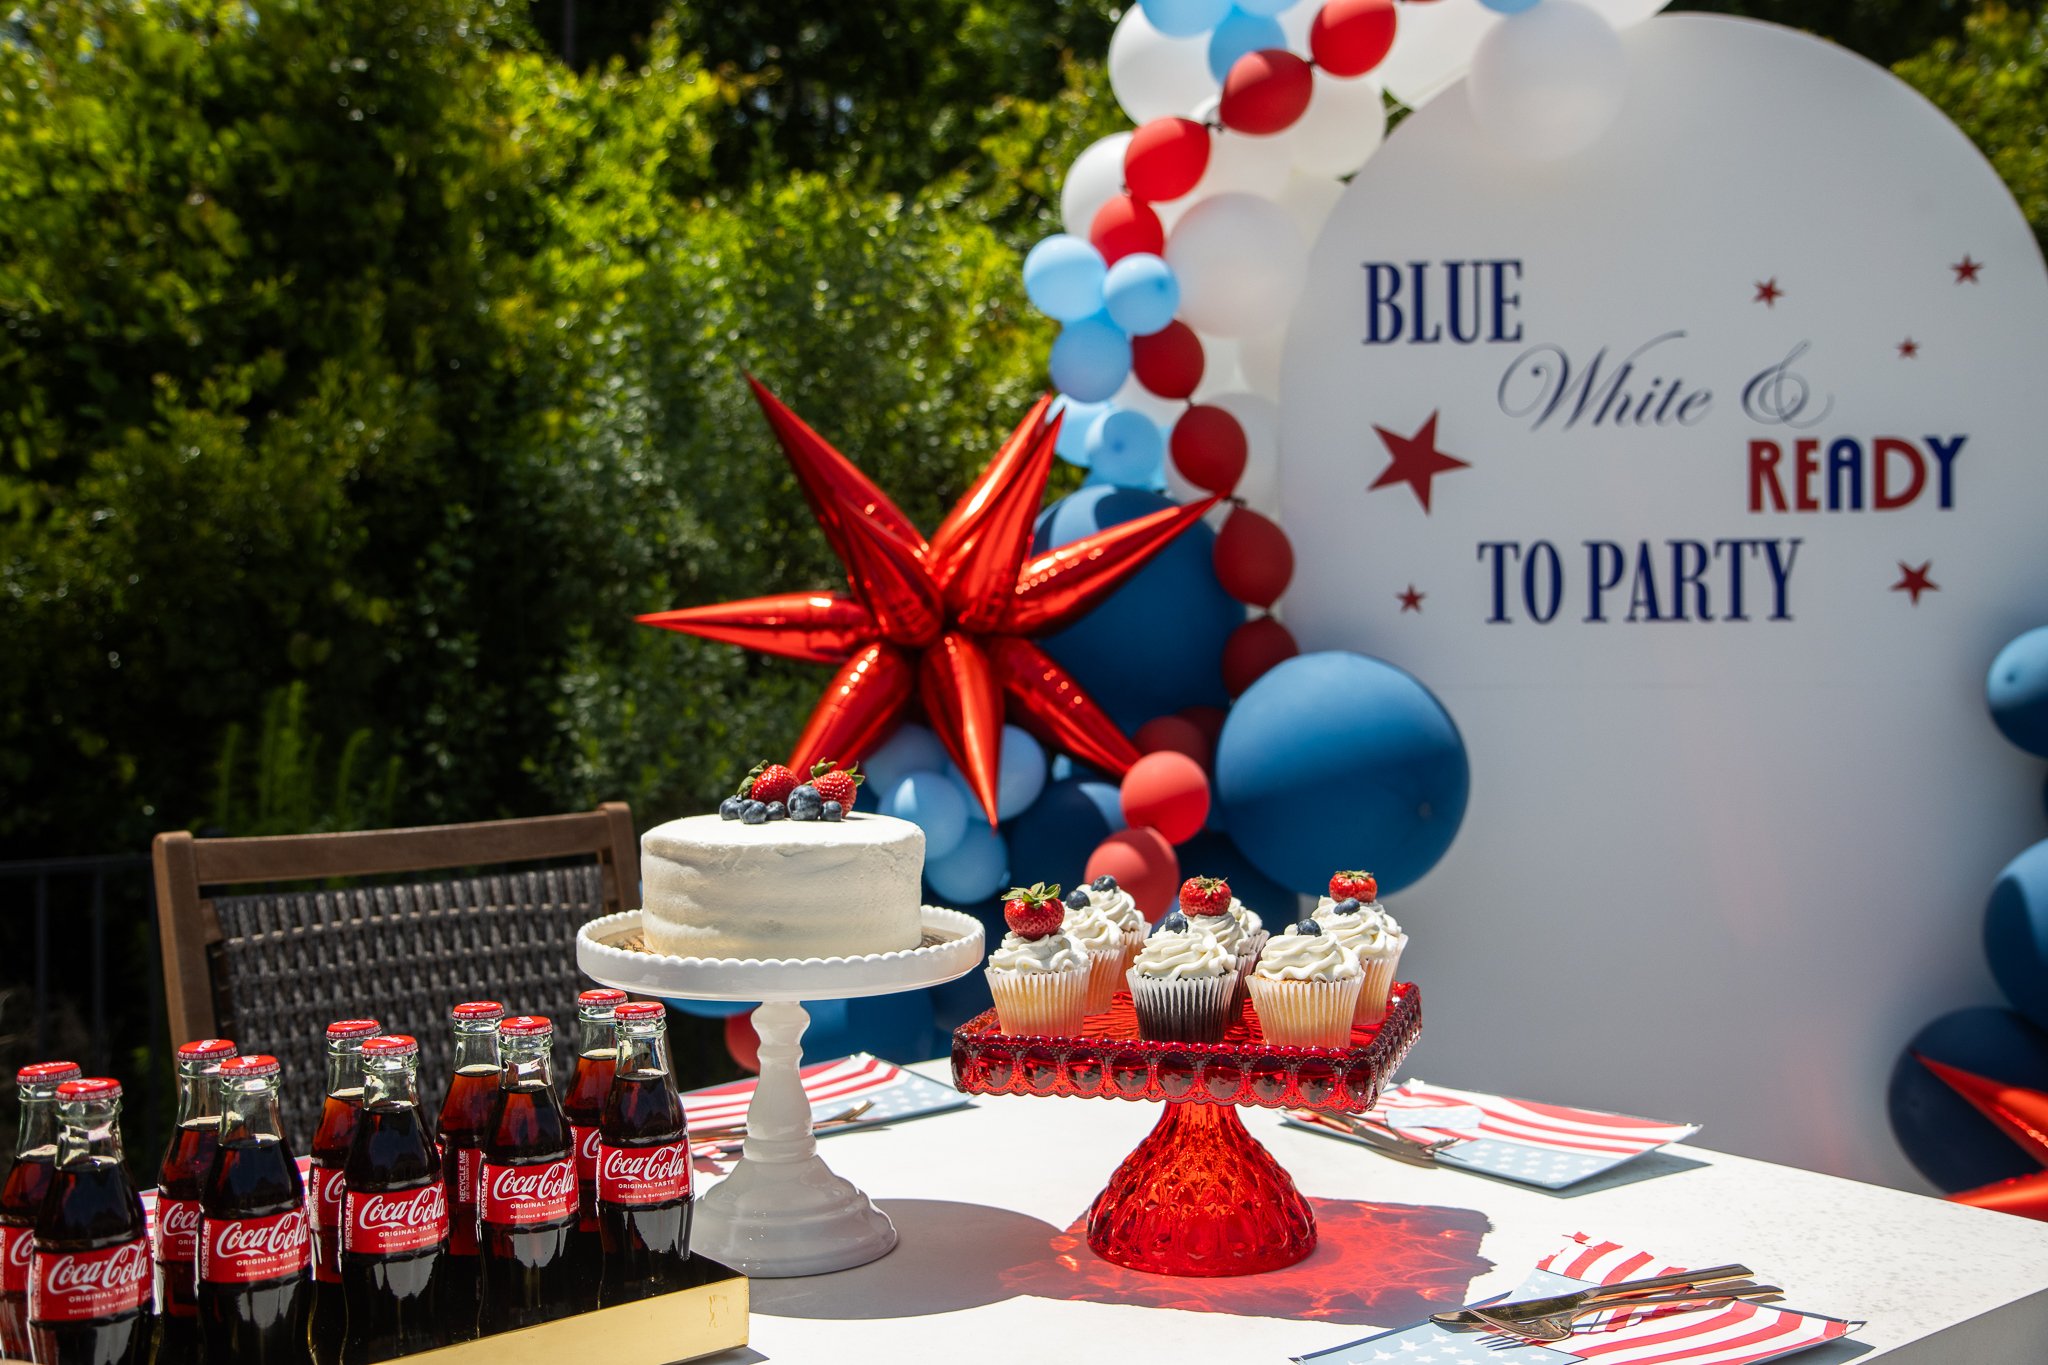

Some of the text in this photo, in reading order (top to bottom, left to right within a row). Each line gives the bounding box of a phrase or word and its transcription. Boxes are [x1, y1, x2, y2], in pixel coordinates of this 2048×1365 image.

[1362, 259, 1523, 344] BLUE
[1497, 330, 1834, 431] White &
[1747, 434, 1968, 513] READY
[1478, 537, 1803, 624] TO PARTY
[459, 1150, 466, 1164] ME
[604, 1142, 685, 1181] Coca-Cola
[493, 1159, 575, 1201] Coca-Cola
[359, 1183, 445, 1230] Coca-Cola
[510, 1196, 567, 1209] ORIGINAL TASTE
[216, 1207, 308, 1258] Coca-Cola
[378, 1222, 439, 1238] ORIGINAL TASTE
[48, 1240, 148, 1295] Coca-Cola
[236, 1249, 300, 1266] ORIGINAL TASTE
[68, 1290, 112, 1303] ORIGINAL
[115, 1283, 138, 1295] TASTE
